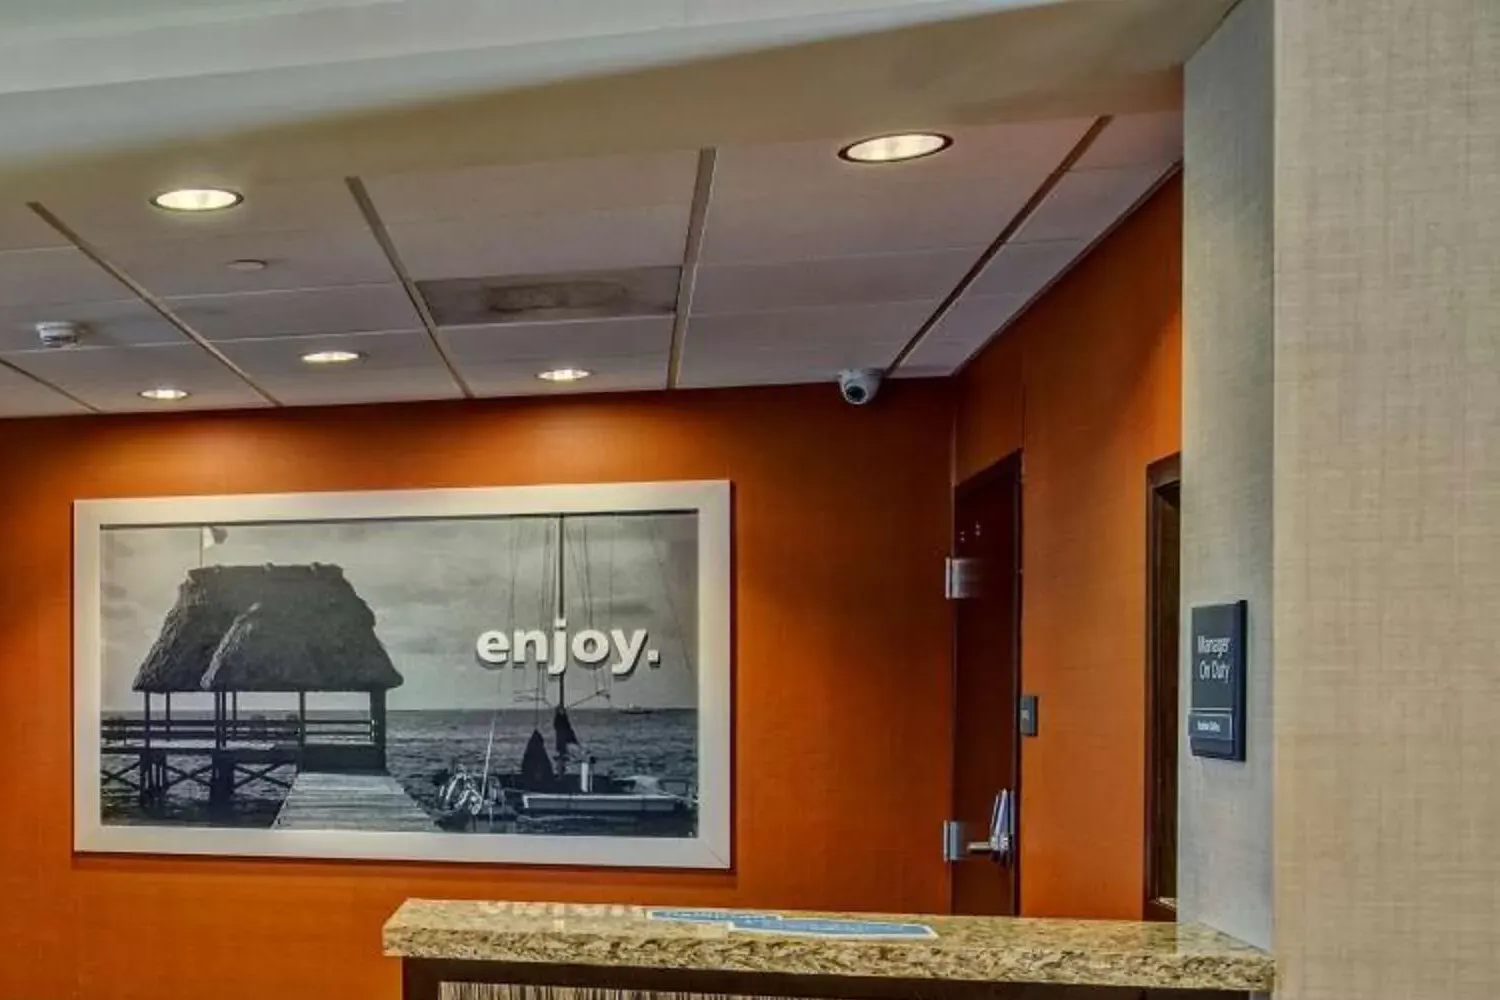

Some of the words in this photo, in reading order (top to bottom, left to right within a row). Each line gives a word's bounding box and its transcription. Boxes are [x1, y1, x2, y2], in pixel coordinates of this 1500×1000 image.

[476, 618, 660, 675] enjoy.
[1200, 660, 1210, 680] On
[1211, 660, 1230, 684] Duty
